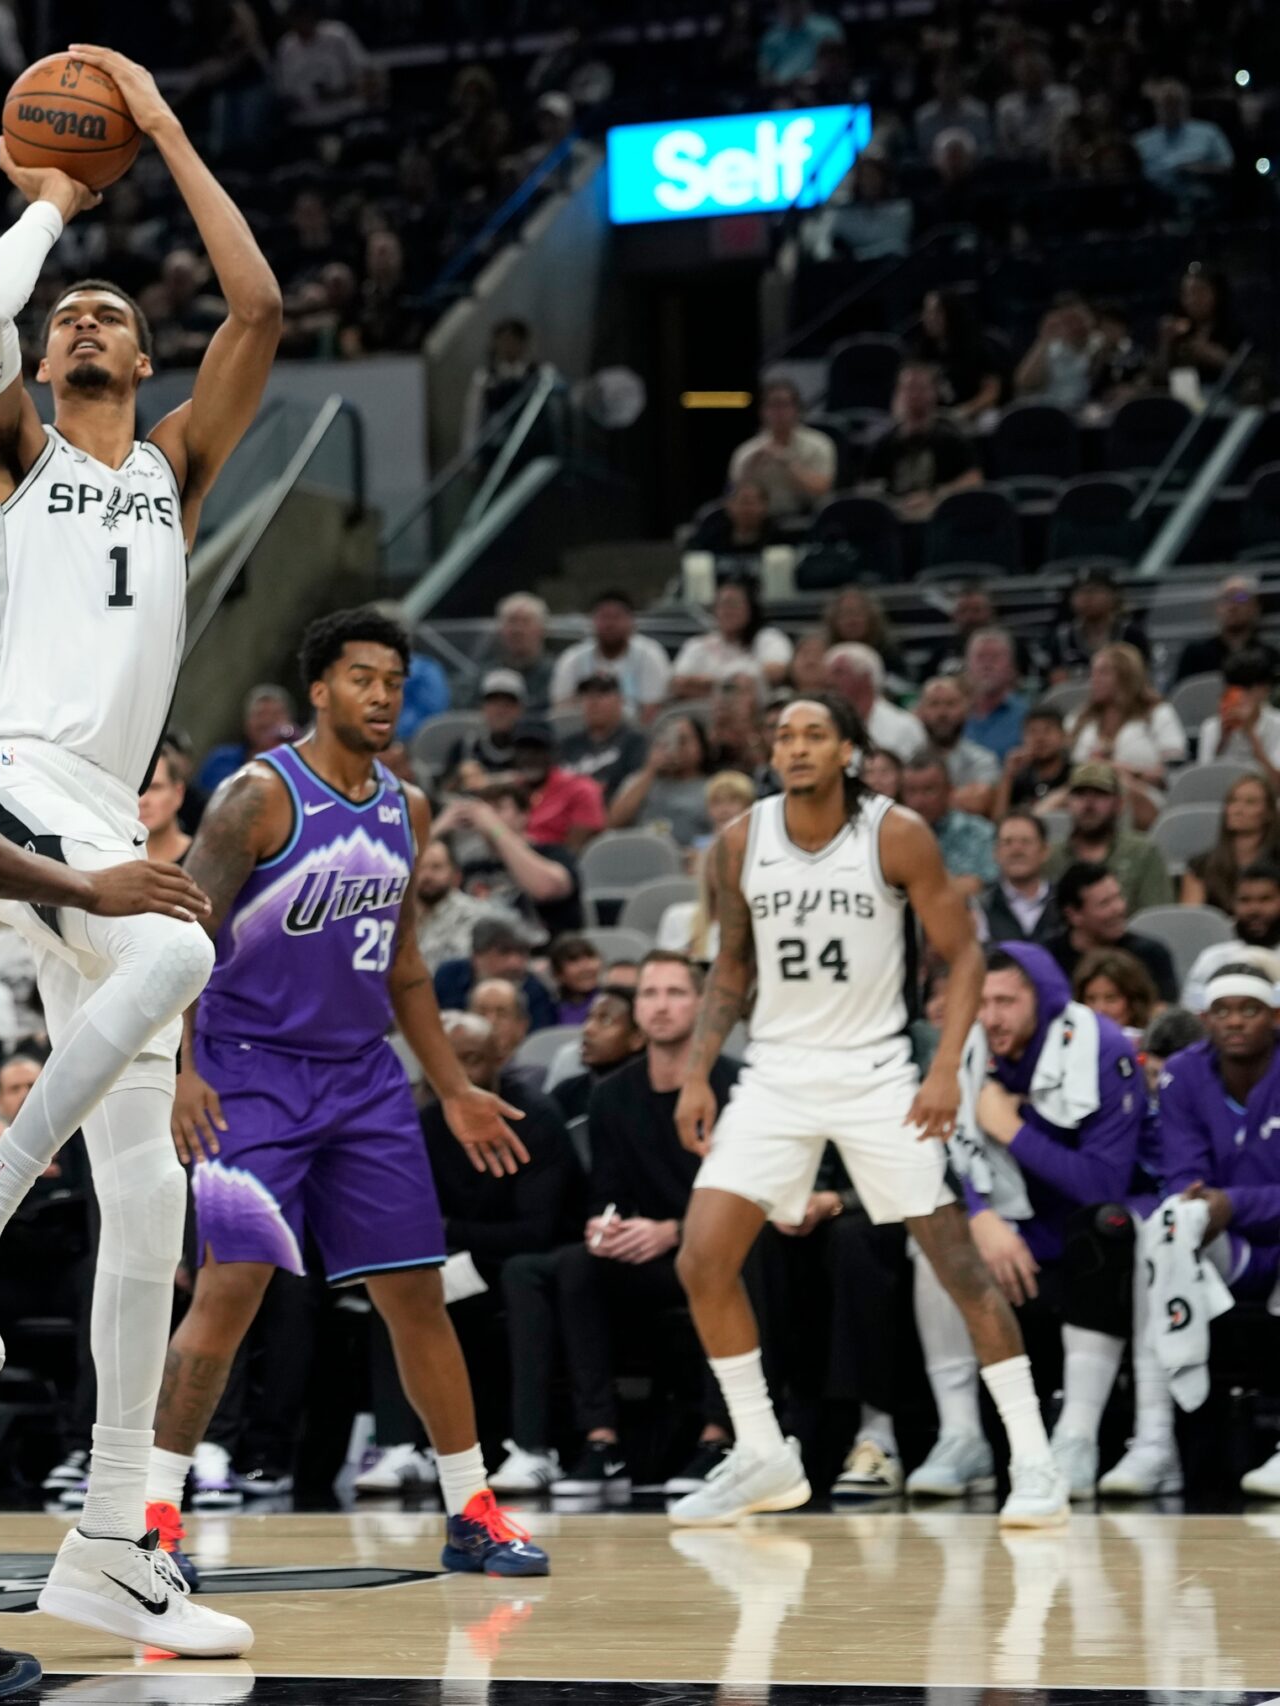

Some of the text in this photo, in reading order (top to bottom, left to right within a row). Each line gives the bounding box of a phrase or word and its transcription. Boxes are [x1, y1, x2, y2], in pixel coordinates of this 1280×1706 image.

[18, 103, 107, 141] Wilson
[652, 117, 815, 211] Self
[48, 483, 173, 530] SPURS
[107, 545, 134, 607] 1
[281, 866, 411, 936] UTAH
[751, 889, 875, 926] SPURS
[352, 917, 396, 972] 23
[778, 938, 849, 982] 24
